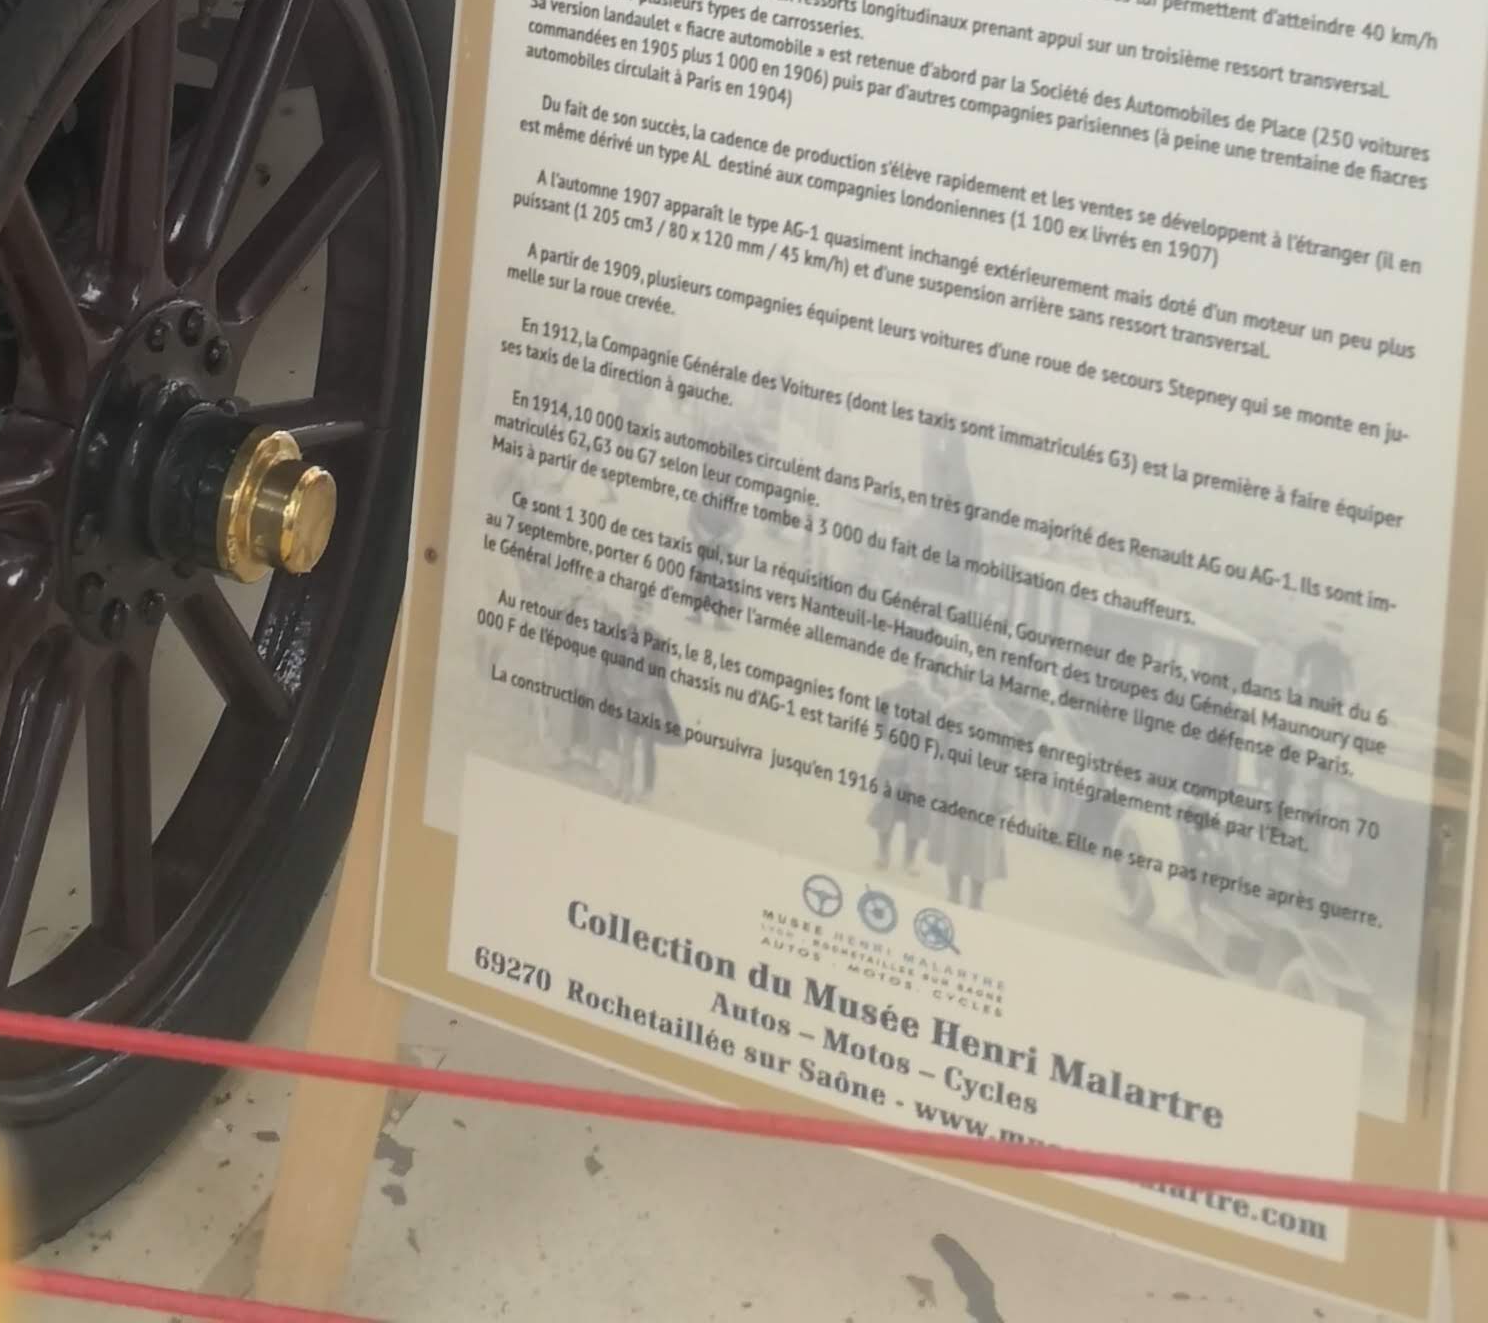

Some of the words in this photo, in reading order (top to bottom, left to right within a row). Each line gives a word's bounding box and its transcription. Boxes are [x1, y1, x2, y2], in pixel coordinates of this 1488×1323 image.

[749, 5, 768, 24] de
[771, 8, 863, 40] carrosseries.
[971, 15, 1035, 45] prenant
[1036, 25, 1083, 53] appui
[1086, 37, 1112, 55] sur
[1115, 42, 1137, 59] un
[1140, 42, 1221, 72] troisième
[1223, 55, 1285, 83] ressort
[1287, 66, 1390, 100] transversal.
[549, 171, 619, 201] l'automne
[623, 186, 661, 210] 1907
[663, 194, 724, 225] apparaît
[727, 207, 743, 226] le
[745, 211, 779, 237] type
[781, 218, 819, 242] AG-1
[823, 226, 905, 262] quasiment
[907, 243, 979, 277] inchangé
[983, 258, 1110, 300] extérieurement
[1114, 283, 1153, 309] mais
[1158, 292, 1197, 317] doté
[1201, 301, 1238, 325] d'un
[1242, 309, 1307, 339] moteur
[1311, 326, 1333, 344] un
[1338, 331, 1373, 356] peu
[1377, 335, 1416, 364] plus
[520, 316, 540, 336] En
[541, 321, 583, 349] 1912,
[583, 330, 599, 350] la
[599, 334, 679, 371] Compagnie
[681, 353, 748, 384] Générale
[751, 368, 778, 391] des
[779, 375, 843, 405] Voitures
[845, 389, 888, 419] (dont
[890, 400, 915, 422] les
[916, 405, 956, 431] taxis
[959, 415, 996, 440] sont
[998, 424, 1105, 465] immatriculés
[1107, 448, 1139, 476] G3)
[1142, 455, 1168, 479] est
[1171, 462, 1189, 484] la
[1192, 467, 1271, 505] première
[1289, 488, 1331, 515] faire
[1335, 498, 1404, 535] équiper
[490, 435, 524, 460] Mais
[537, 447, 578, 476] partir
[580, 458, 598, 479] de
[600, 463, 680, 502] septembre,
[681, 487, 698, 504] ce
[700, 488, 750, 517] chiffre
[752, 501, 801, 529] tombe
[831, 520, 864, 545] 000
[867, 529, 887, 551] du
[890, 535, 918, 559] fait
[921, 542, 942, 565] de
[945, 548, 961, 570] la
[964, 553, 1066, 595] mobilisation
[1069, 579, 1099, 604] des
[1102, 587, 1195, 627] chauffeurs.
[489, 663, 508, 685] La
[509, 671, 595, 711] construction
[597, 697, 623, 721] des
[625, 705, 661, 732] taxis
[664, 720, 680, 738] se
[683, 723, 764, 765] poursuivra
[770, 748, 834, 786] jusqu'en
[895, 787, 926, 809] une
[929, 793, 996, 829] cadence
[998, 812, 1062, 847] réduite.
[1065, 830, 1098, 857] Elle
[1101, 843, 1123, 864] ne
[1127, 850, 1164, 874] sera
[1167, 860, 1198, 887] pas
[1200, 865, 1262, 904] reprise
[1265, 882, 1314, 917] après
[1319, 899, 1381, 935] guerre.
[473, 942, 552, 994] 69270
[566, 976, 736, 1059] Rochetaillée
[743, 1043, 791, 1077] sur
[799, 1055, 886, 1108] Saône
[566, 897, 738, 982] Collection
[747, 958, 793, 1000] du
[802, 975, 921, 1041] Musée
[930, 1014, 1039, 1078] Henri
[1048, 1050, 1224, 1135] Malartre
[760, 935, 822, 963] AUTOS
[847, 961, 913, 991] MOTOS
[931, 987, 1004, 1019] CYCLES
[761, 908, 824, 937] MUSEE
[902, 951, 1006, 992] MALARTRE
[710, 989, 792, 1038] Autos
[822, 1026, 911, 1076] Motos
[942, 1063, 1039, 1124] Cycles
